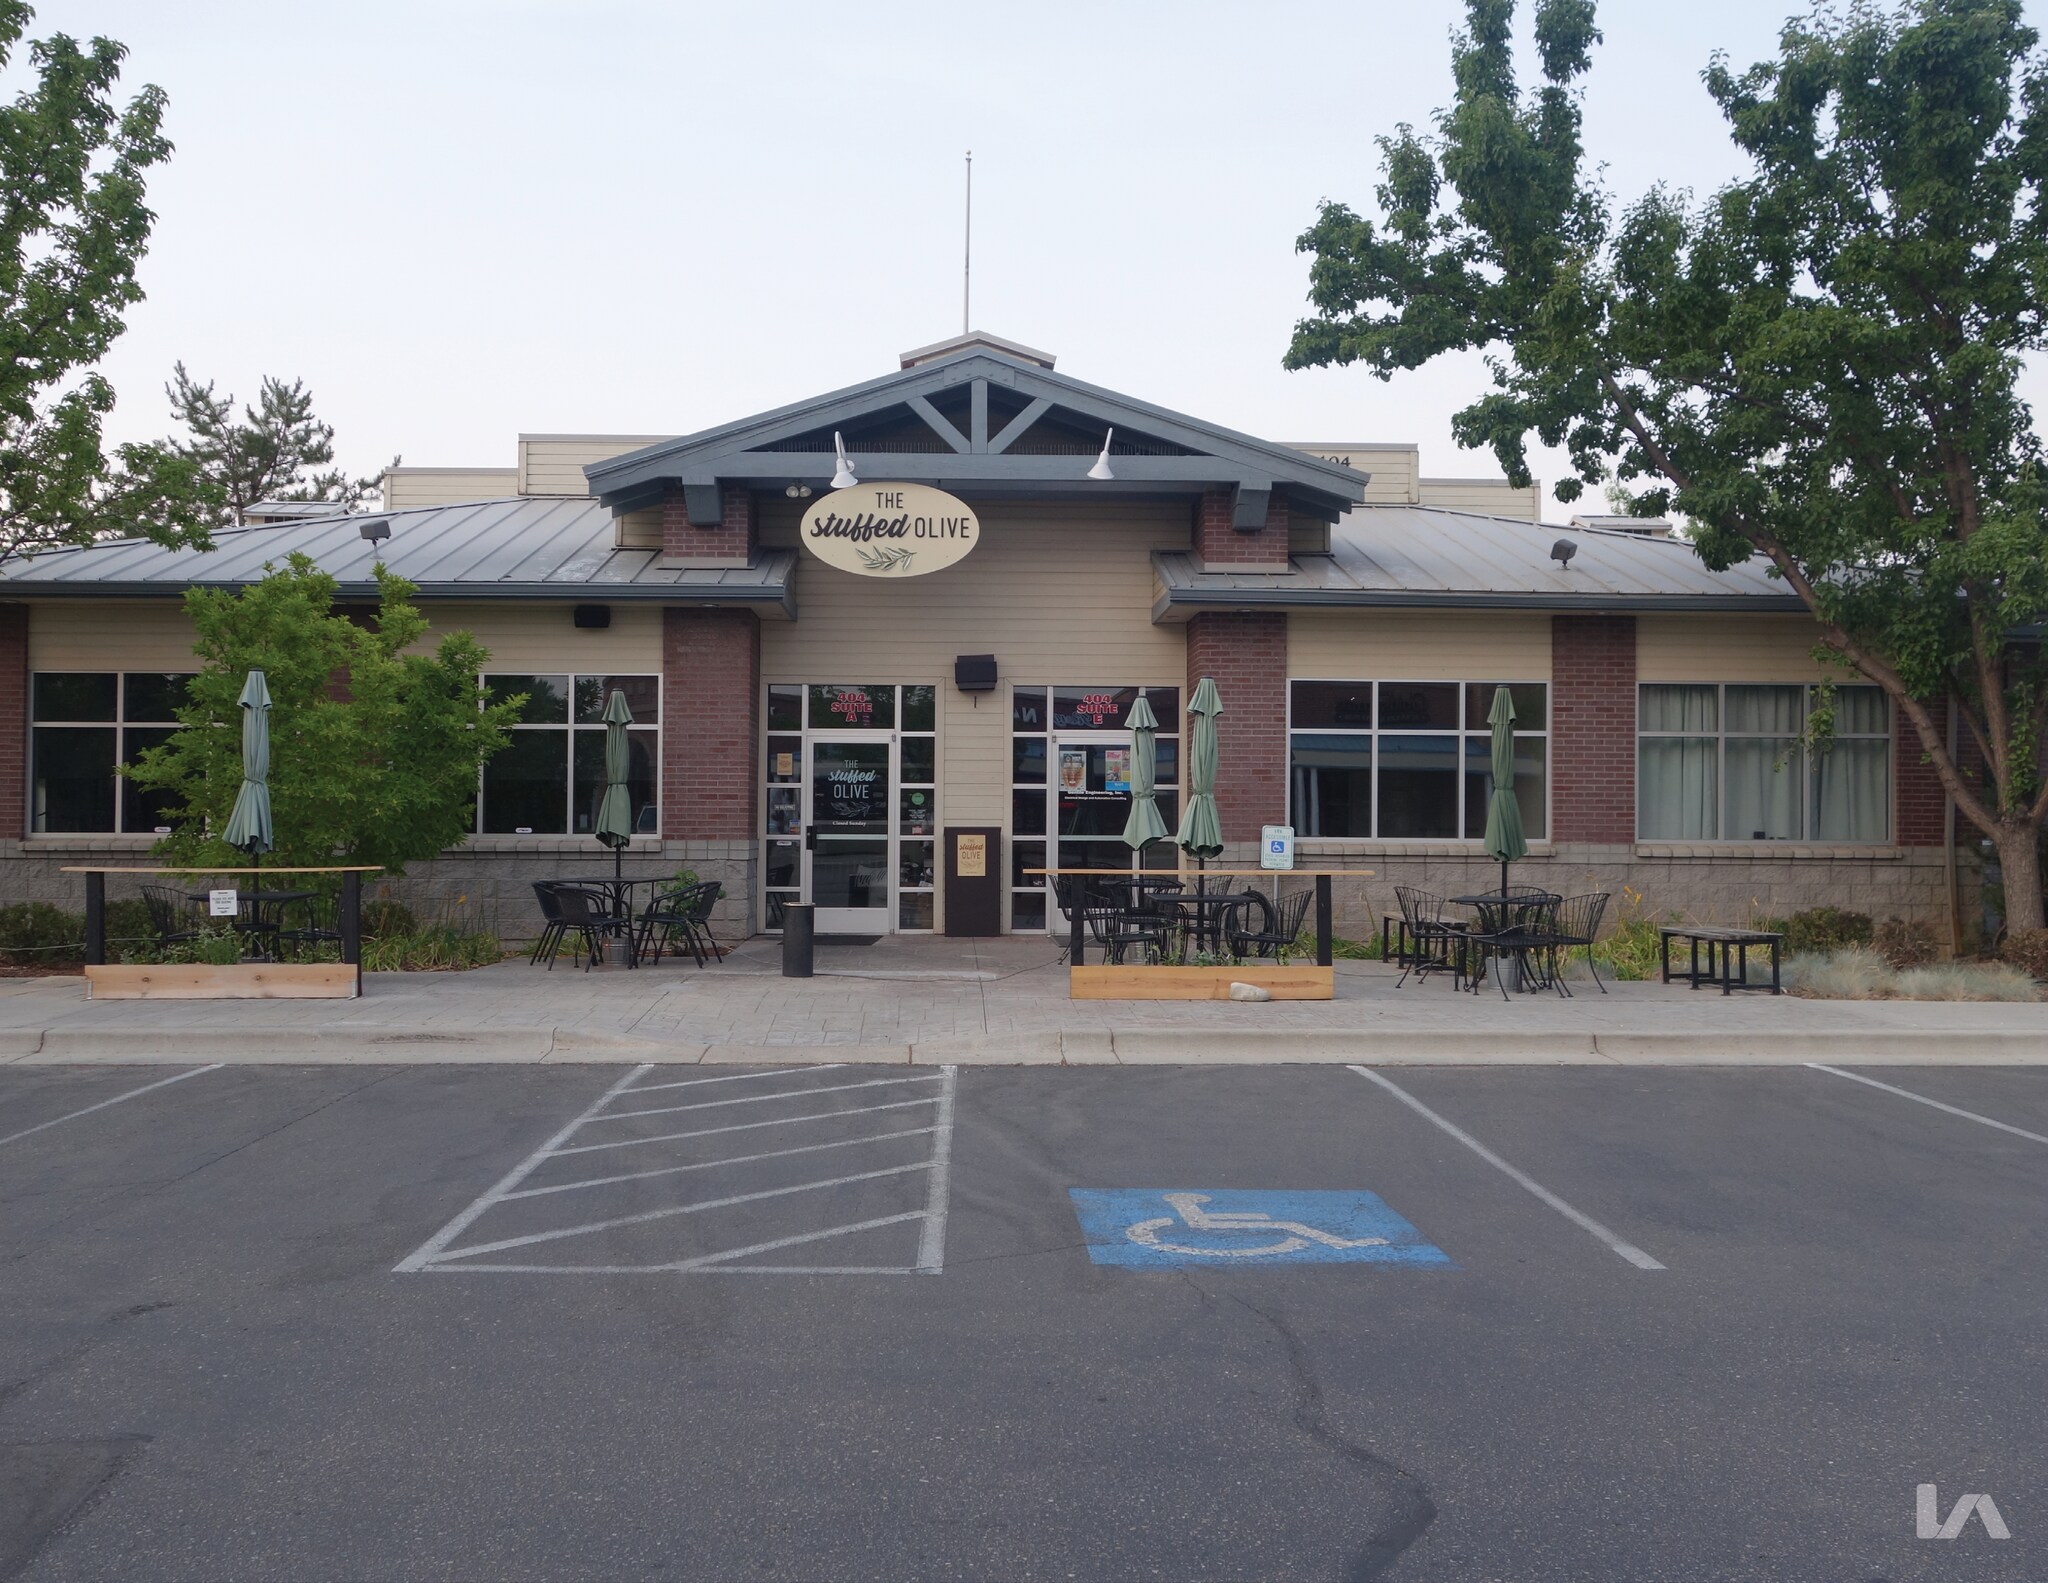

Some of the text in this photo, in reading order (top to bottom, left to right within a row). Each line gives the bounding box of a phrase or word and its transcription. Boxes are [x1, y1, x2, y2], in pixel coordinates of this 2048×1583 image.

[875, 492, 904, 509] THE
[810, 512, 970, 542] stuffed OLIVE
[837, 692, 866, 702] 404
[1083, 694, 1112, 704] 404
[831, 702, 872, 712] SUITE
[1077, 704, 1118, 714] SUITE
[846, 711, 857, 722] A
[1093, 713, 1103, 724] E
[845, 760, 858, 768] THE
[828, 769, 876, 783] stuffed
[833, 784, 869, 799] OLIVE
[961, 851, 981, 860] OLIVE
